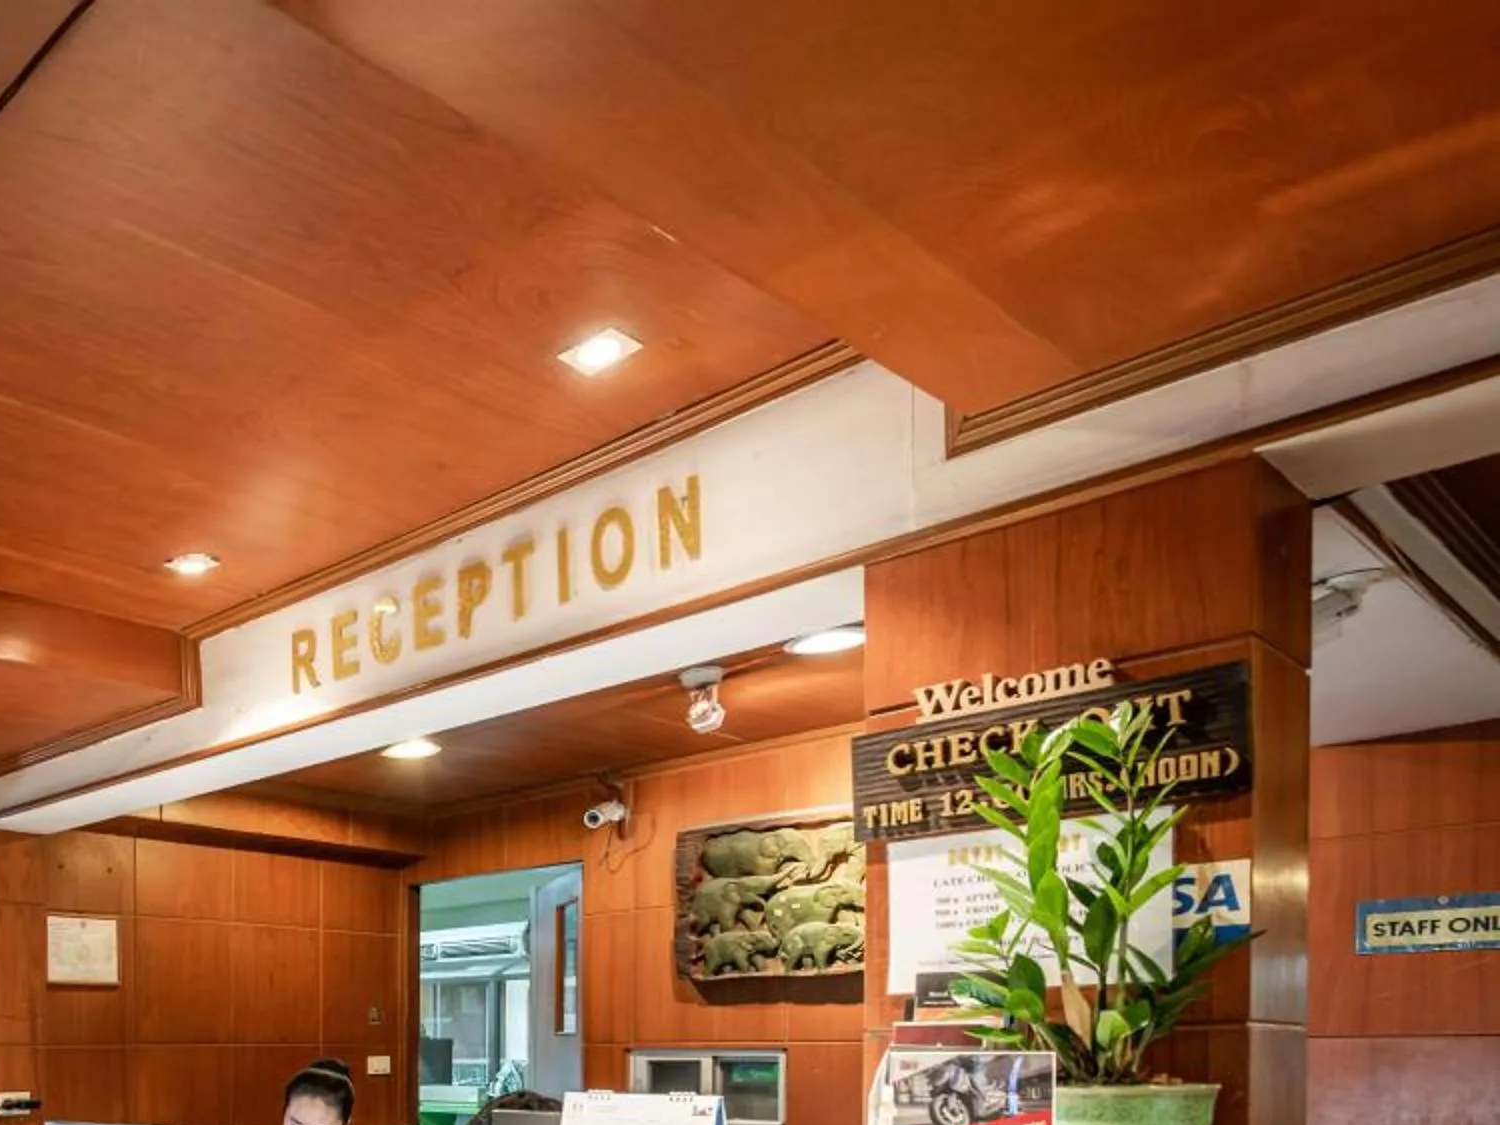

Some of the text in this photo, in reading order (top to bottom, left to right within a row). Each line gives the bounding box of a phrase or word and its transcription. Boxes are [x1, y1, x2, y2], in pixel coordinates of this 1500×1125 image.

[291, 474, 702, 694] RECEPTION
[914, 657, 1116, 720] Welcome
[863, 798, 925, 829] TIME
[1172, 873, 1240, 915] SA
[1373, 915, 1500, 937] STAFF ONL
